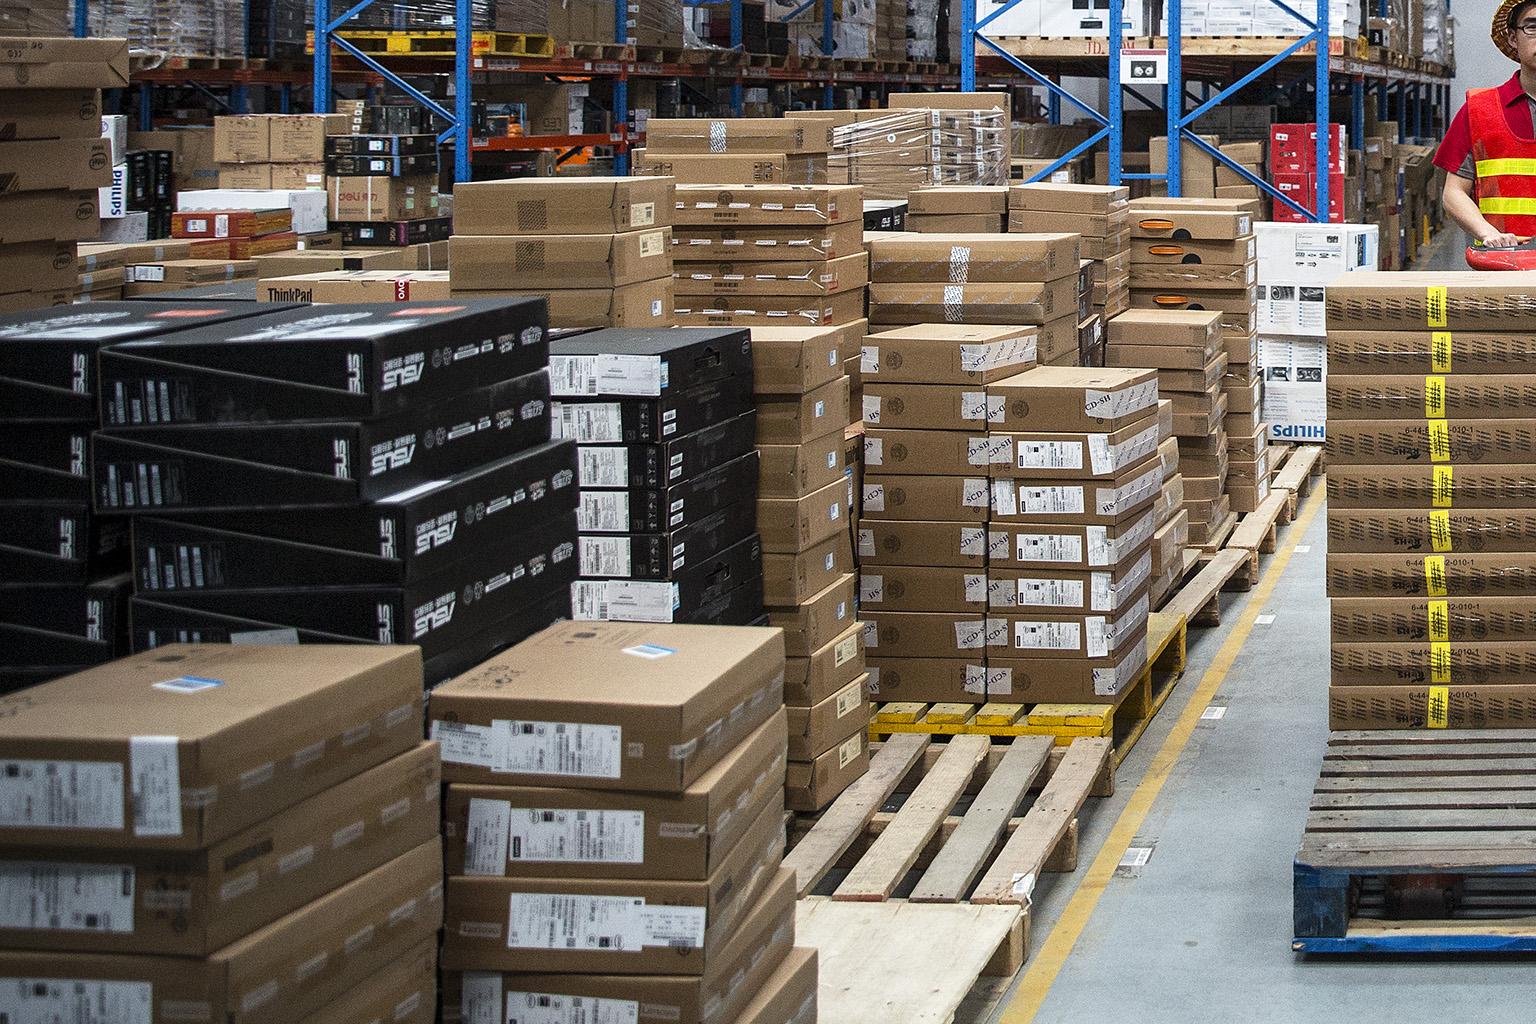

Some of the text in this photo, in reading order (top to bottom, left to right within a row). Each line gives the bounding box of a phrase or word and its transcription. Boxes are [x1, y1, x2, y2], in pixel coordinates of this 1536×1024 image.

[110, 170, 122, 217] PHILIPS
[266, 287, 312, 302] ThinkPad
[381, 362, 425, 391] ASUS
[1085, 394, 1111, 412] CD-SH
[1272, 424, 1325, 438] HILIPS
[988, 438, 1013, 458] CD-SH
[370, 444, 416, 475] ASUS
[966, 486, 989, 504] SCD-S
[415, 520, 458, 555] ASUS
[960, 530, 985, 549] CD-SH
[413, 600, 457, 639] ASUS
[962, 626, 986, 646] SCD-S
